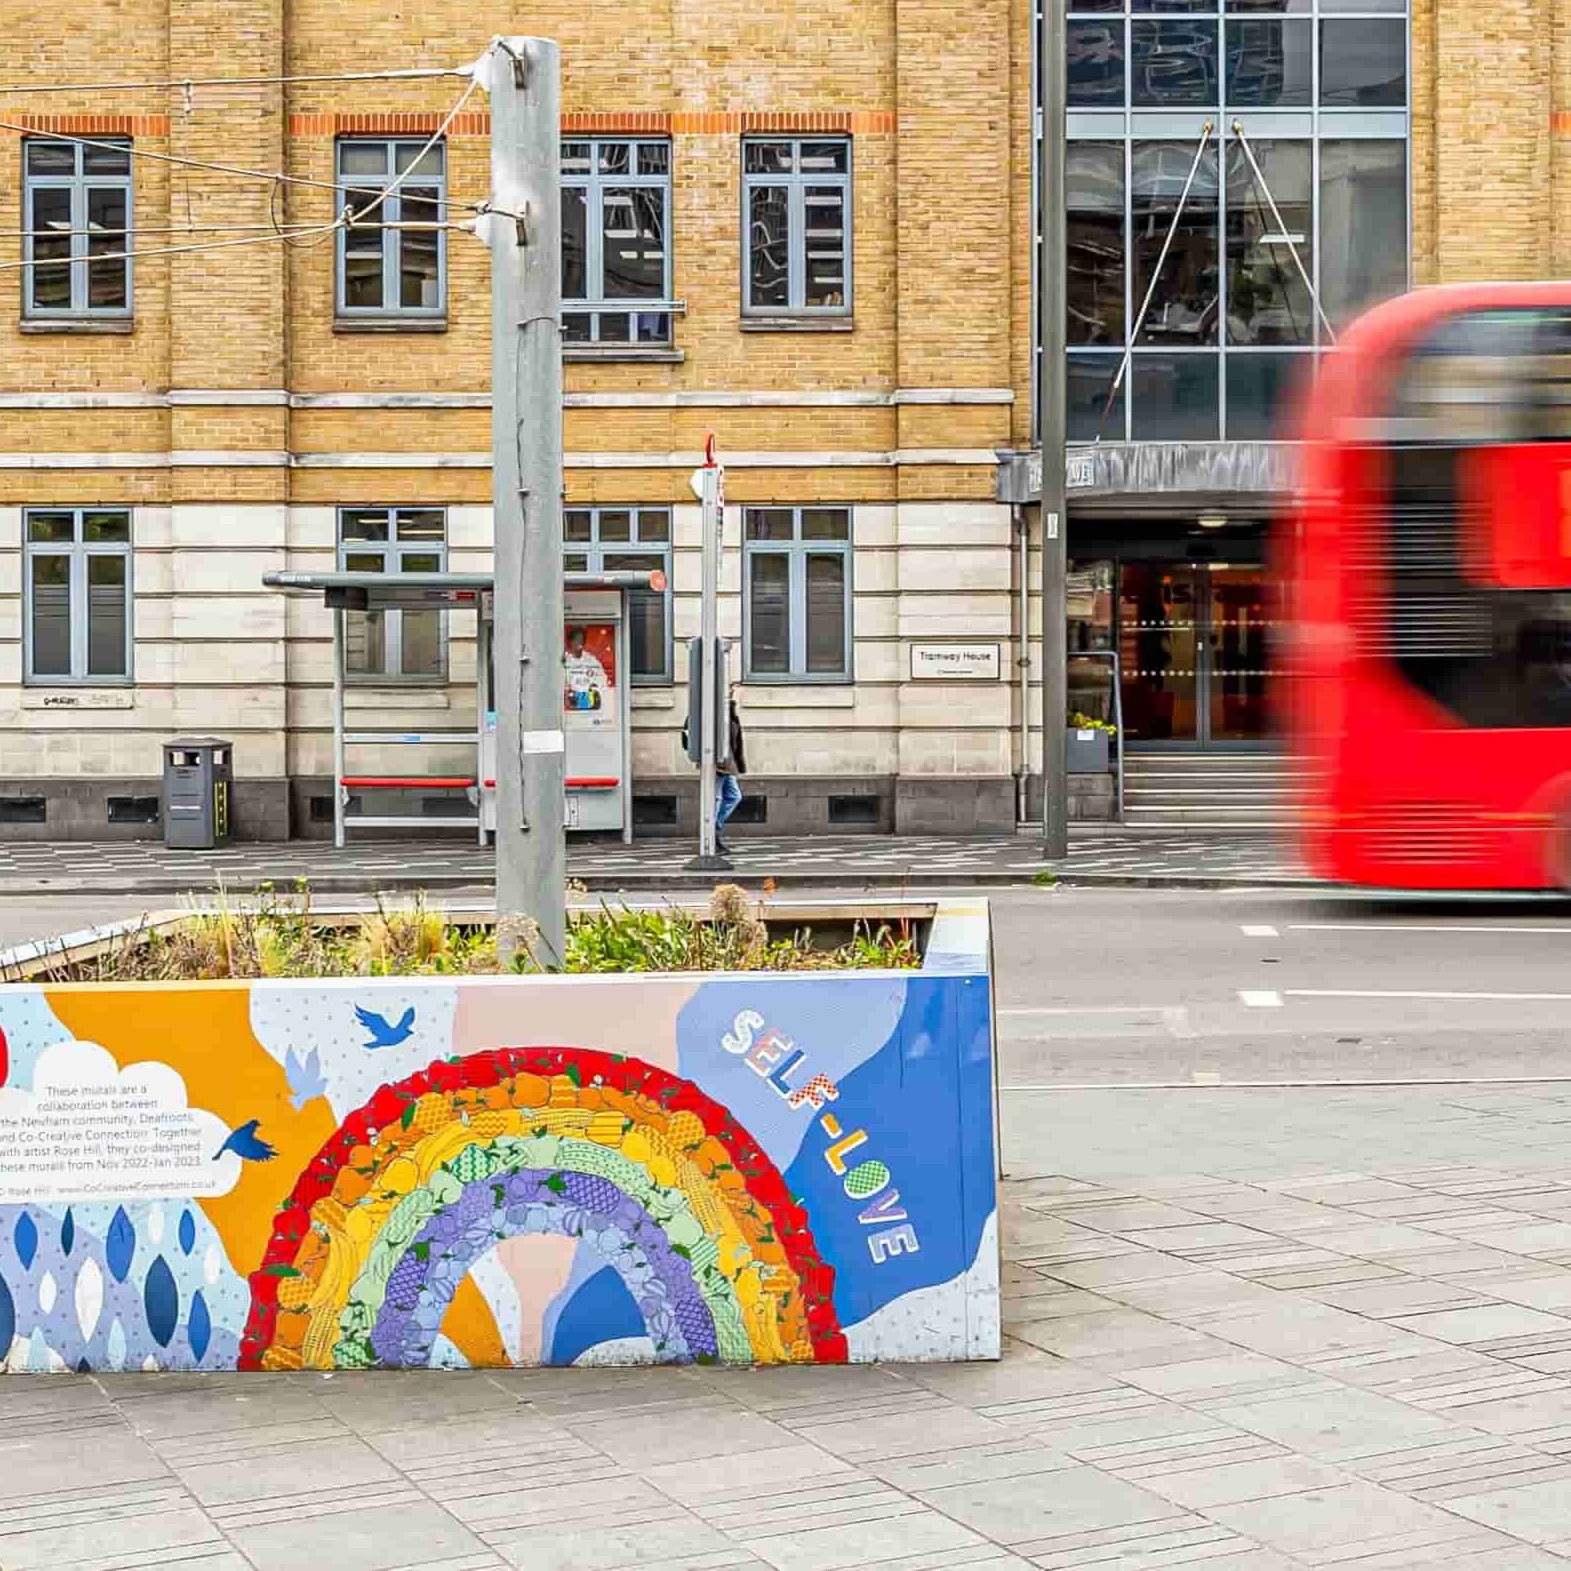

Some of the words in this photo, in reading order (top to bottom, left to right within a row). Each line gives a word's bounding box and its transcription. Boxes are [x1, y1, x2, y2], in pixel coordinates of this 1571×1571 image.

[920, 651, 960, 663] Tramway
[963, 651, 991, 661] House
[45, 1086, 78, 1096] These
[82, 1085, 116, 1096] murals
[120, 1084, 137, 1094] are
[37, 1100, 108, 1112] collaboration
[111, 1100, 157, 1110] between
[0, 1117, 18, 1128] the
[21, 1116, 70, 1127] Newham
[19, 1132, 82, 1143] Co-Creative
[24, 1146, 51, 1157] artist
[54, 1145, 80, 1156] Rose
[107, 1143, 130, 1156] they
[133, 1141, 201, 1155] co-designed
[28, 1162, 64, 1172] murals
[68, 1159, 94, 1172] from
[97, 1159, 119, 1169] Nov
[8, 1188, 31, 1196] Rose
